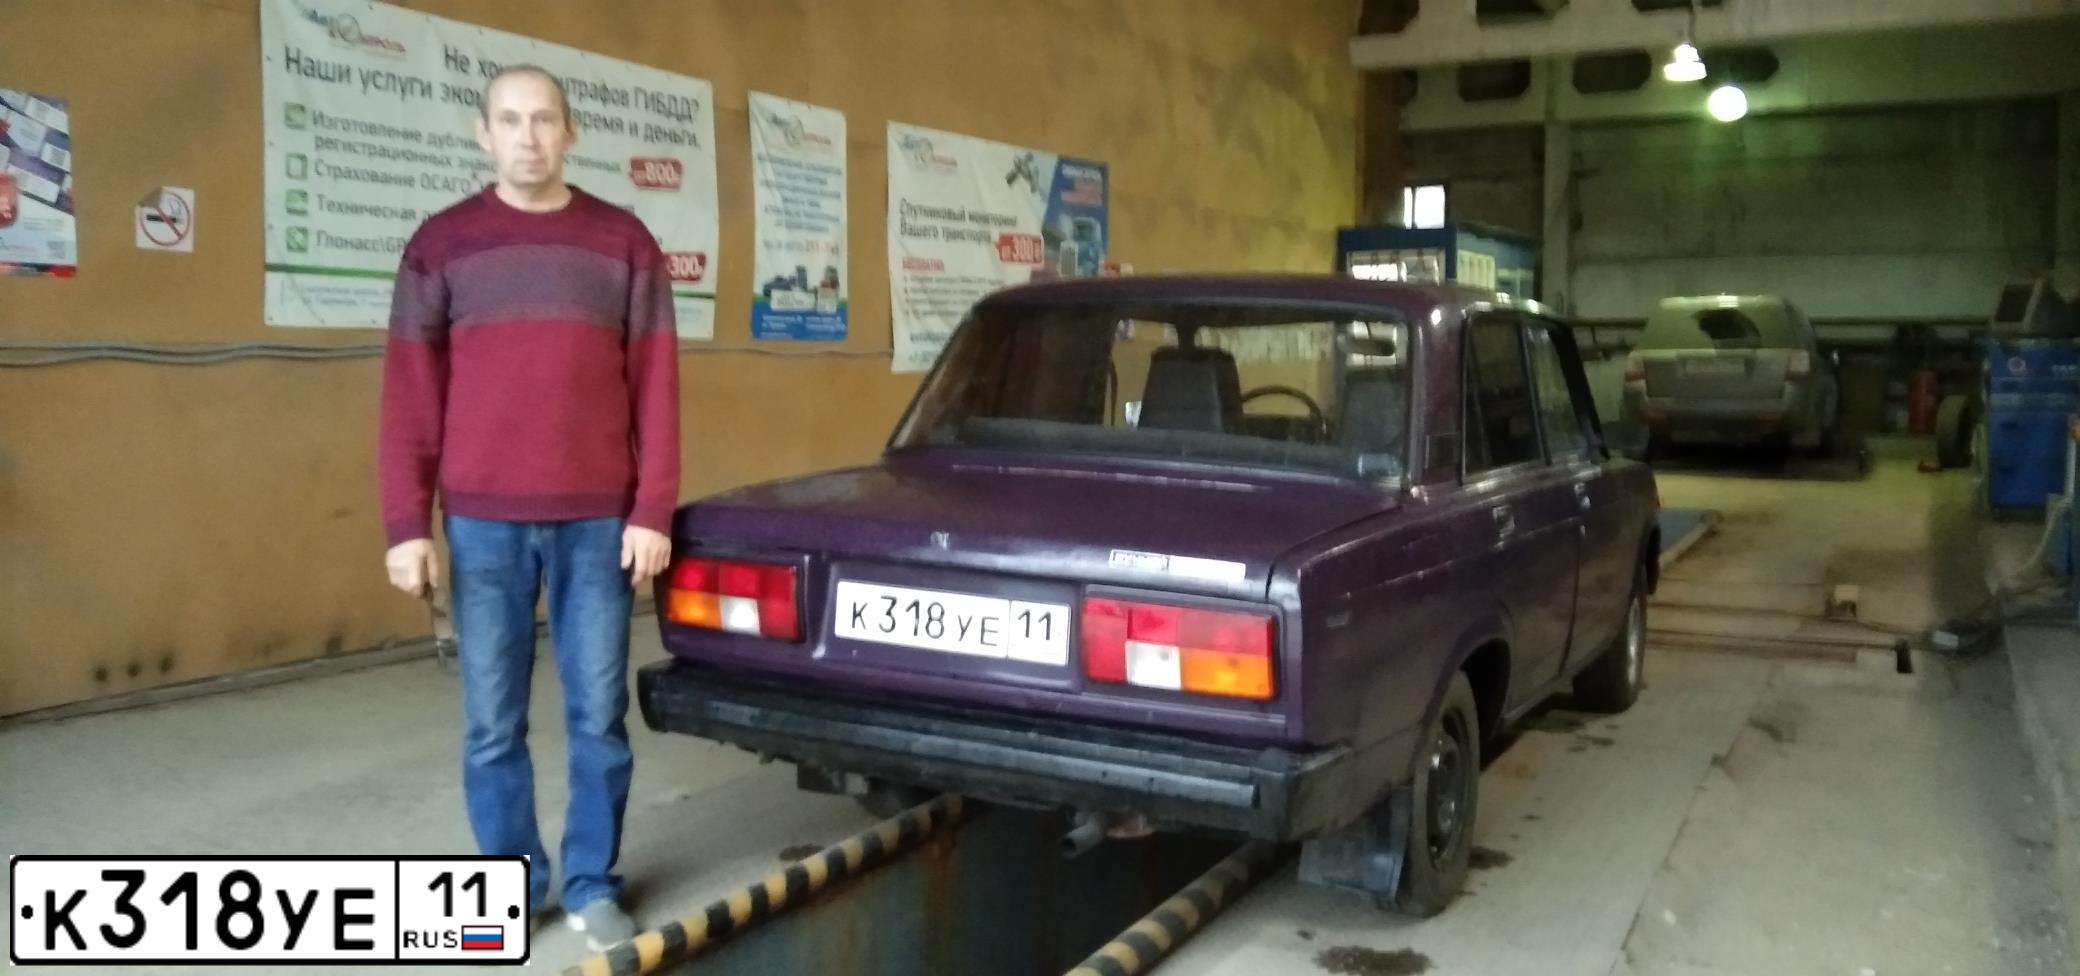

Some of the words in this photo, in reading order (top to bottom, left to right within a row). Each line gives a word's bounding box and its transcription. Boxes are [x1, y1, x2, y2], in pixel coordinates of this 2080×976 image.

[285, 45, 352, 84] Наши
[358, 67, 433, 102] услуги
[628, 118, 639, 137] и
[443, 44, 470, 74] Не
[633, 85, 701, 124] ГИБДД?
[312, 110, 422, 144] Изготовление
[314, 134, 453, 169] регистрационных
[314, 157, 416, 189] Страхование
[315, 193, 417, 221] Техническая
[1017, 610, 1052, 642] 11
